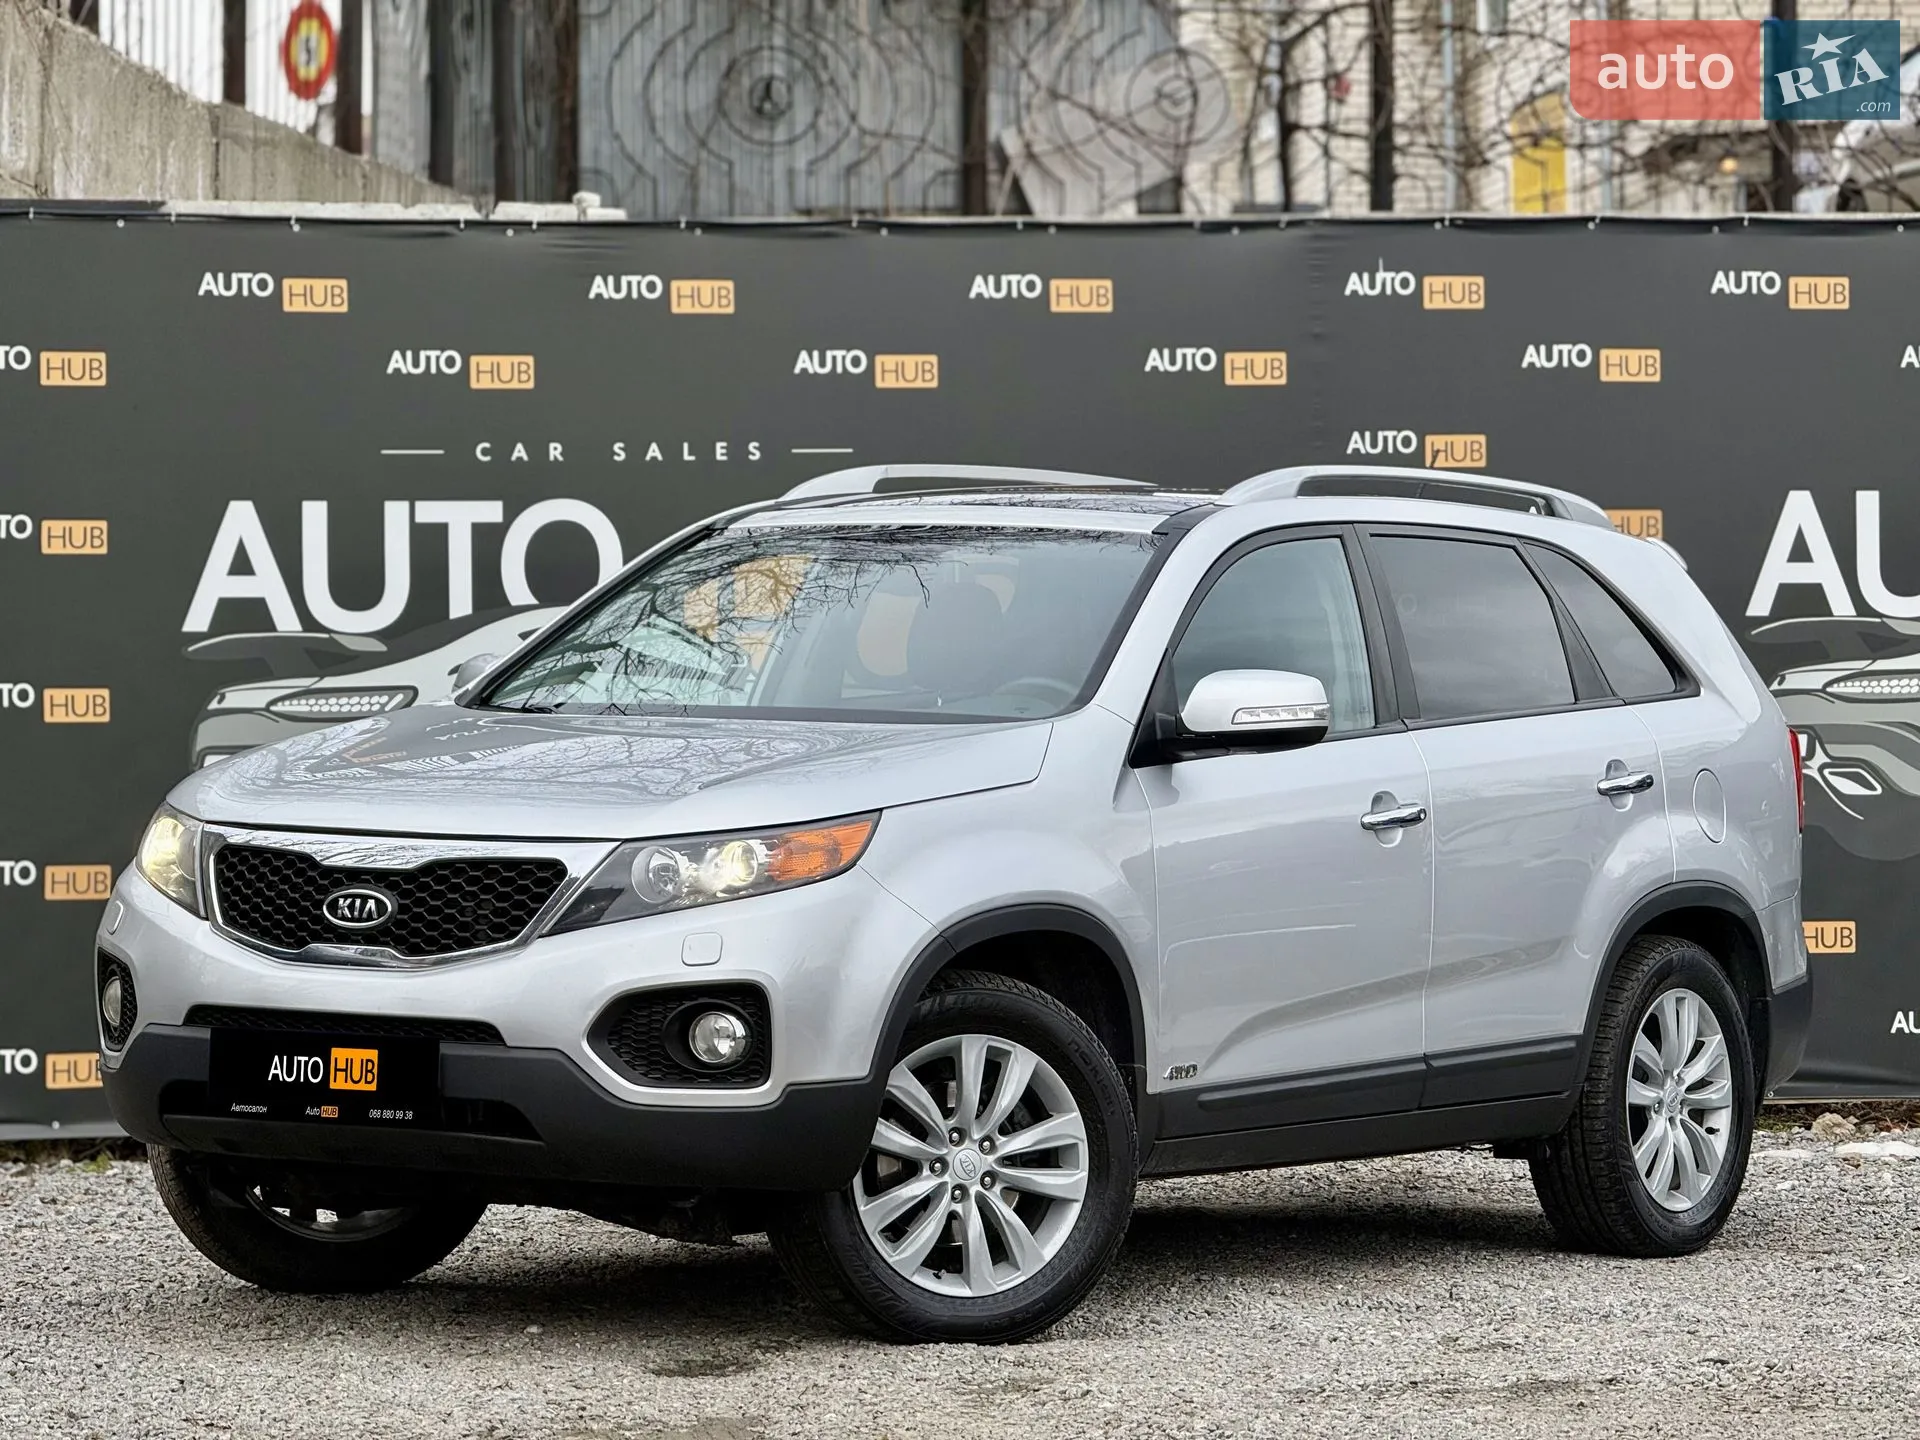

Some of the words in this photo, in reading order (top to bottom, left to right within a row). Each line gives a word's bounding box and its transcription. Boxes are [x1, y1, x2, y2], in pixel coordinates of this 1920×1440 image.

[197, 271, 275, 298] AUTO
[288, 284, 345, 308] HUB
[588, 274, 663, 300] AUTO
[676, 286, 731, 309] HUB
[968, 273, 1043, 299] AUTO
[1055, 285, 1110, 308] HUB
[1344, 271, 1416, 296] AUTO
[1428, 281, 1482, 305] HUB
[1710, 270, 1782, 295] AUTO
[1794, 282, 1847, 305] HUB
[46, 357, 104, 382] HUB
[386, 349, 462, 375] AUTO
[475, 361, 532, 385] HUB
[793, 349, 868, 375] AUTO
[881, 360, 935, 384] HUB
[1144, 347, 1217, 372] AUTO
[1230, 357, 1284, 381] HUB
[1521, 343, 1593, 369] AUTO
[1605, 354, 1658, 377] HUB
[475, 442, 565, 462] CAR
[612, 441, 763, 462] SALES
[1346, 430, 1418, 454] AUTO
[1430, 440, 1484, 463] HUB
[47, 525, 105, 550] HUB
[181, 498, 624, 634] AUTO
[49, 694, 108, 718] HUB
[50, 870, 109, 895] HUB
[336, 897, 379, 919] KIA
[267, 1055, 324, 1083] AUTO
[332, 1056, 376, 1085] HUB
[230, 1102, 268, 1113] Автосалон
[305, 1106, 320, 1116] Auto
[321, 1106, 338, 1117] HUB
[368, 1109, 381, 1119] 068
[382, 1109, 394, 1119] 880
[395, 1110, 404, 1120] 99
[404, 1110, 413, 1120] 38
